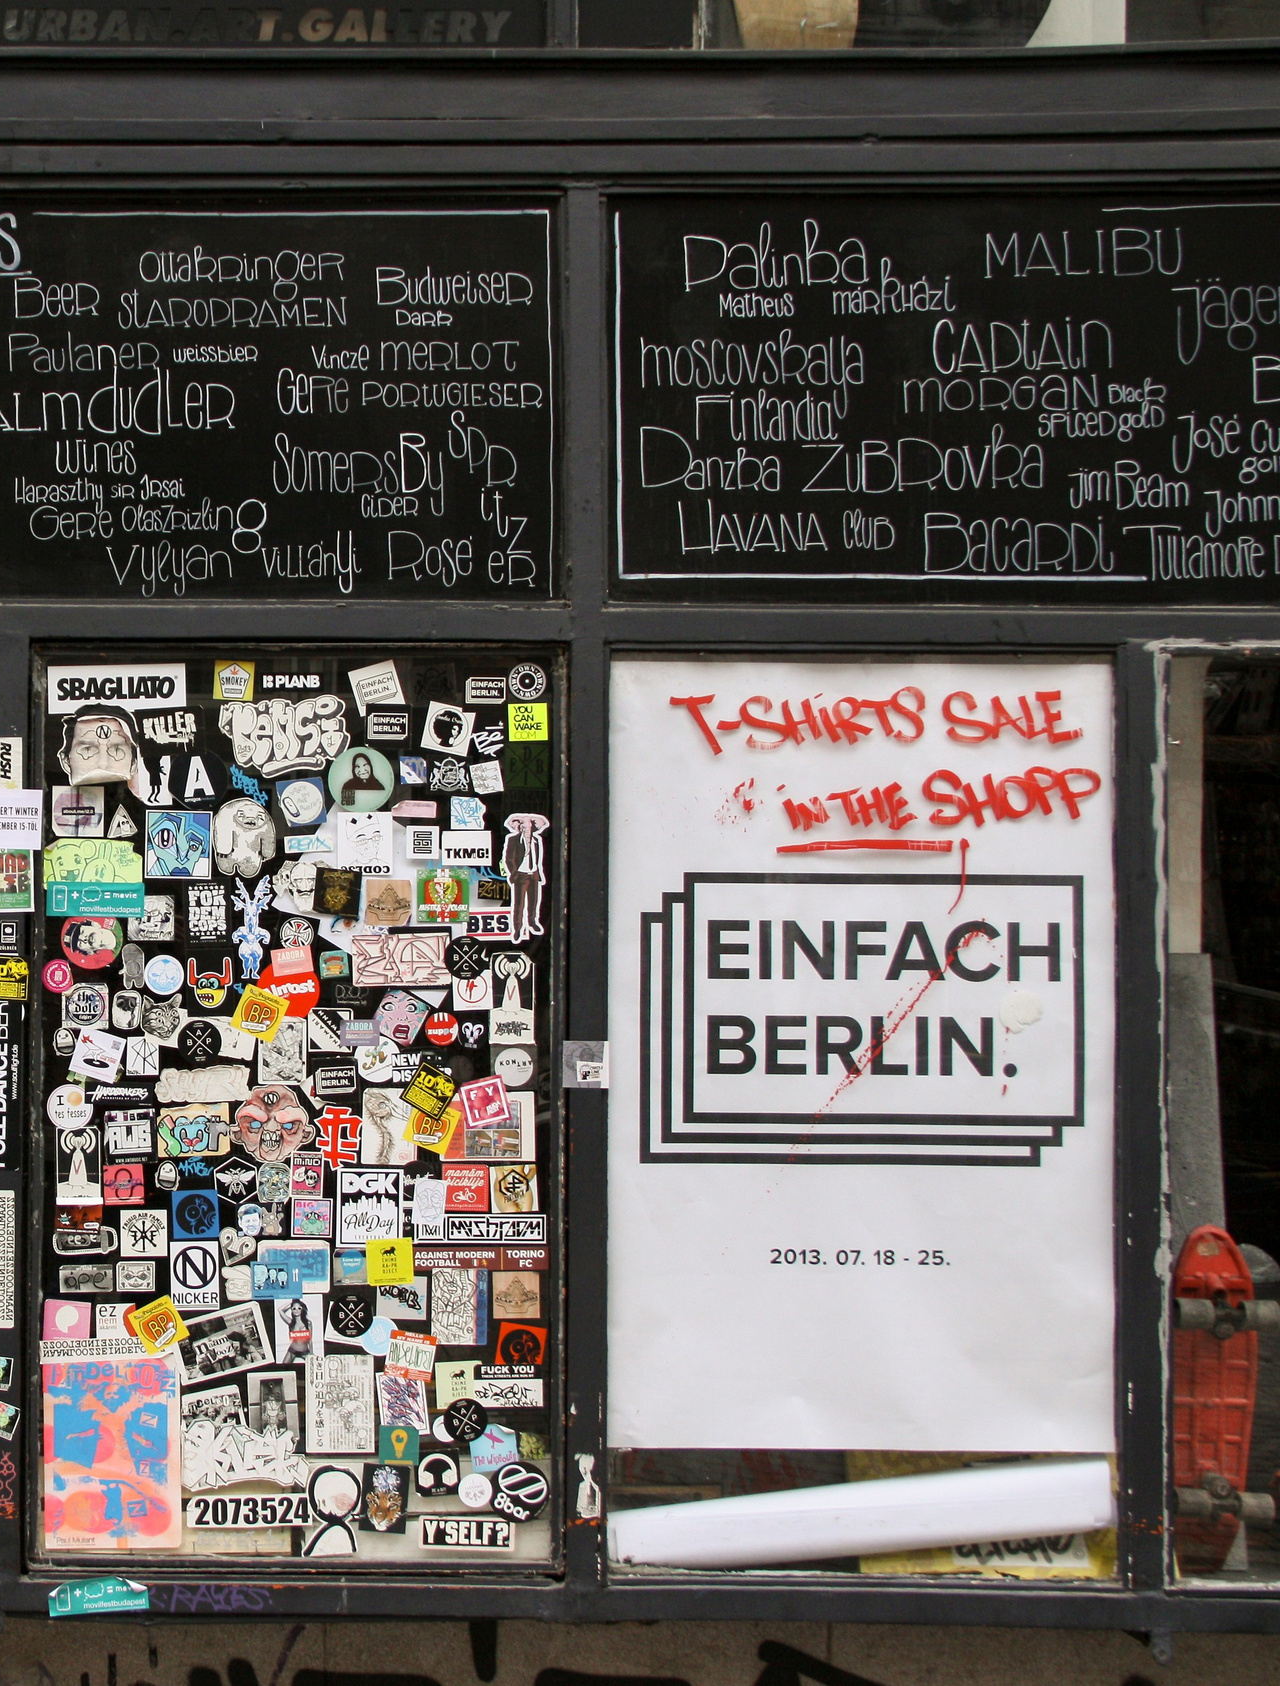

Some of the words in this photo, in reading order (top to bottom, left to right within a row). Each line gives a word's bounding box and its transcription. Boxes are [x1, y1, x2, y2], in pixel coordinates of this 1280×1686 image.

[984, 228, 1184, 279] MALIBU
[719, 293, 796, 318] Matheus
[1114, 460, 1190, 510] Beam
[678, 500, 828, 555] HAVANA
[56, 676, 176, 700] SBAGLIATO
[143, 711, 197, 742] KILLER
[670, 686, 925, 755] T-SHIRTS
[941, 690, 1083, 745] SALE
[826, 782, 918, 831] THE
[923, 766, 1101, 827] SHOPP
[445, 848, 489, 859] TKMG!
[189, 890, 226, 906] FOK
[188, 906, 226, 921] DEM
[188, 921, 227, 932] COPS
[707, 920, 1061, 983] EINFACH
[706, 1015, 1018, 1078] BERLIN.
[343, 1173, 398, 1194] DGK
[414, 1259, 461, 1267] FOOTBALL
[519, 1259, 533, 1267] FC
[506, 1250, 545, 1258] TORINO
[770, 1248, 828, 1267] 2013.
[836, 1248, 866, 1267] 07.
[873, 1248, 895, 1267] 18
[917, 1248, 951, 1267] 25.
[173, 1292, 218, 1304] NICKER
[481, 1366, 507, 1374] FUCK
[509, 1366, 534, 1374] YOU
[195, 1497, 312, 1525] 2073524
[424, 1520, 510, 1547] Y'SELF?
